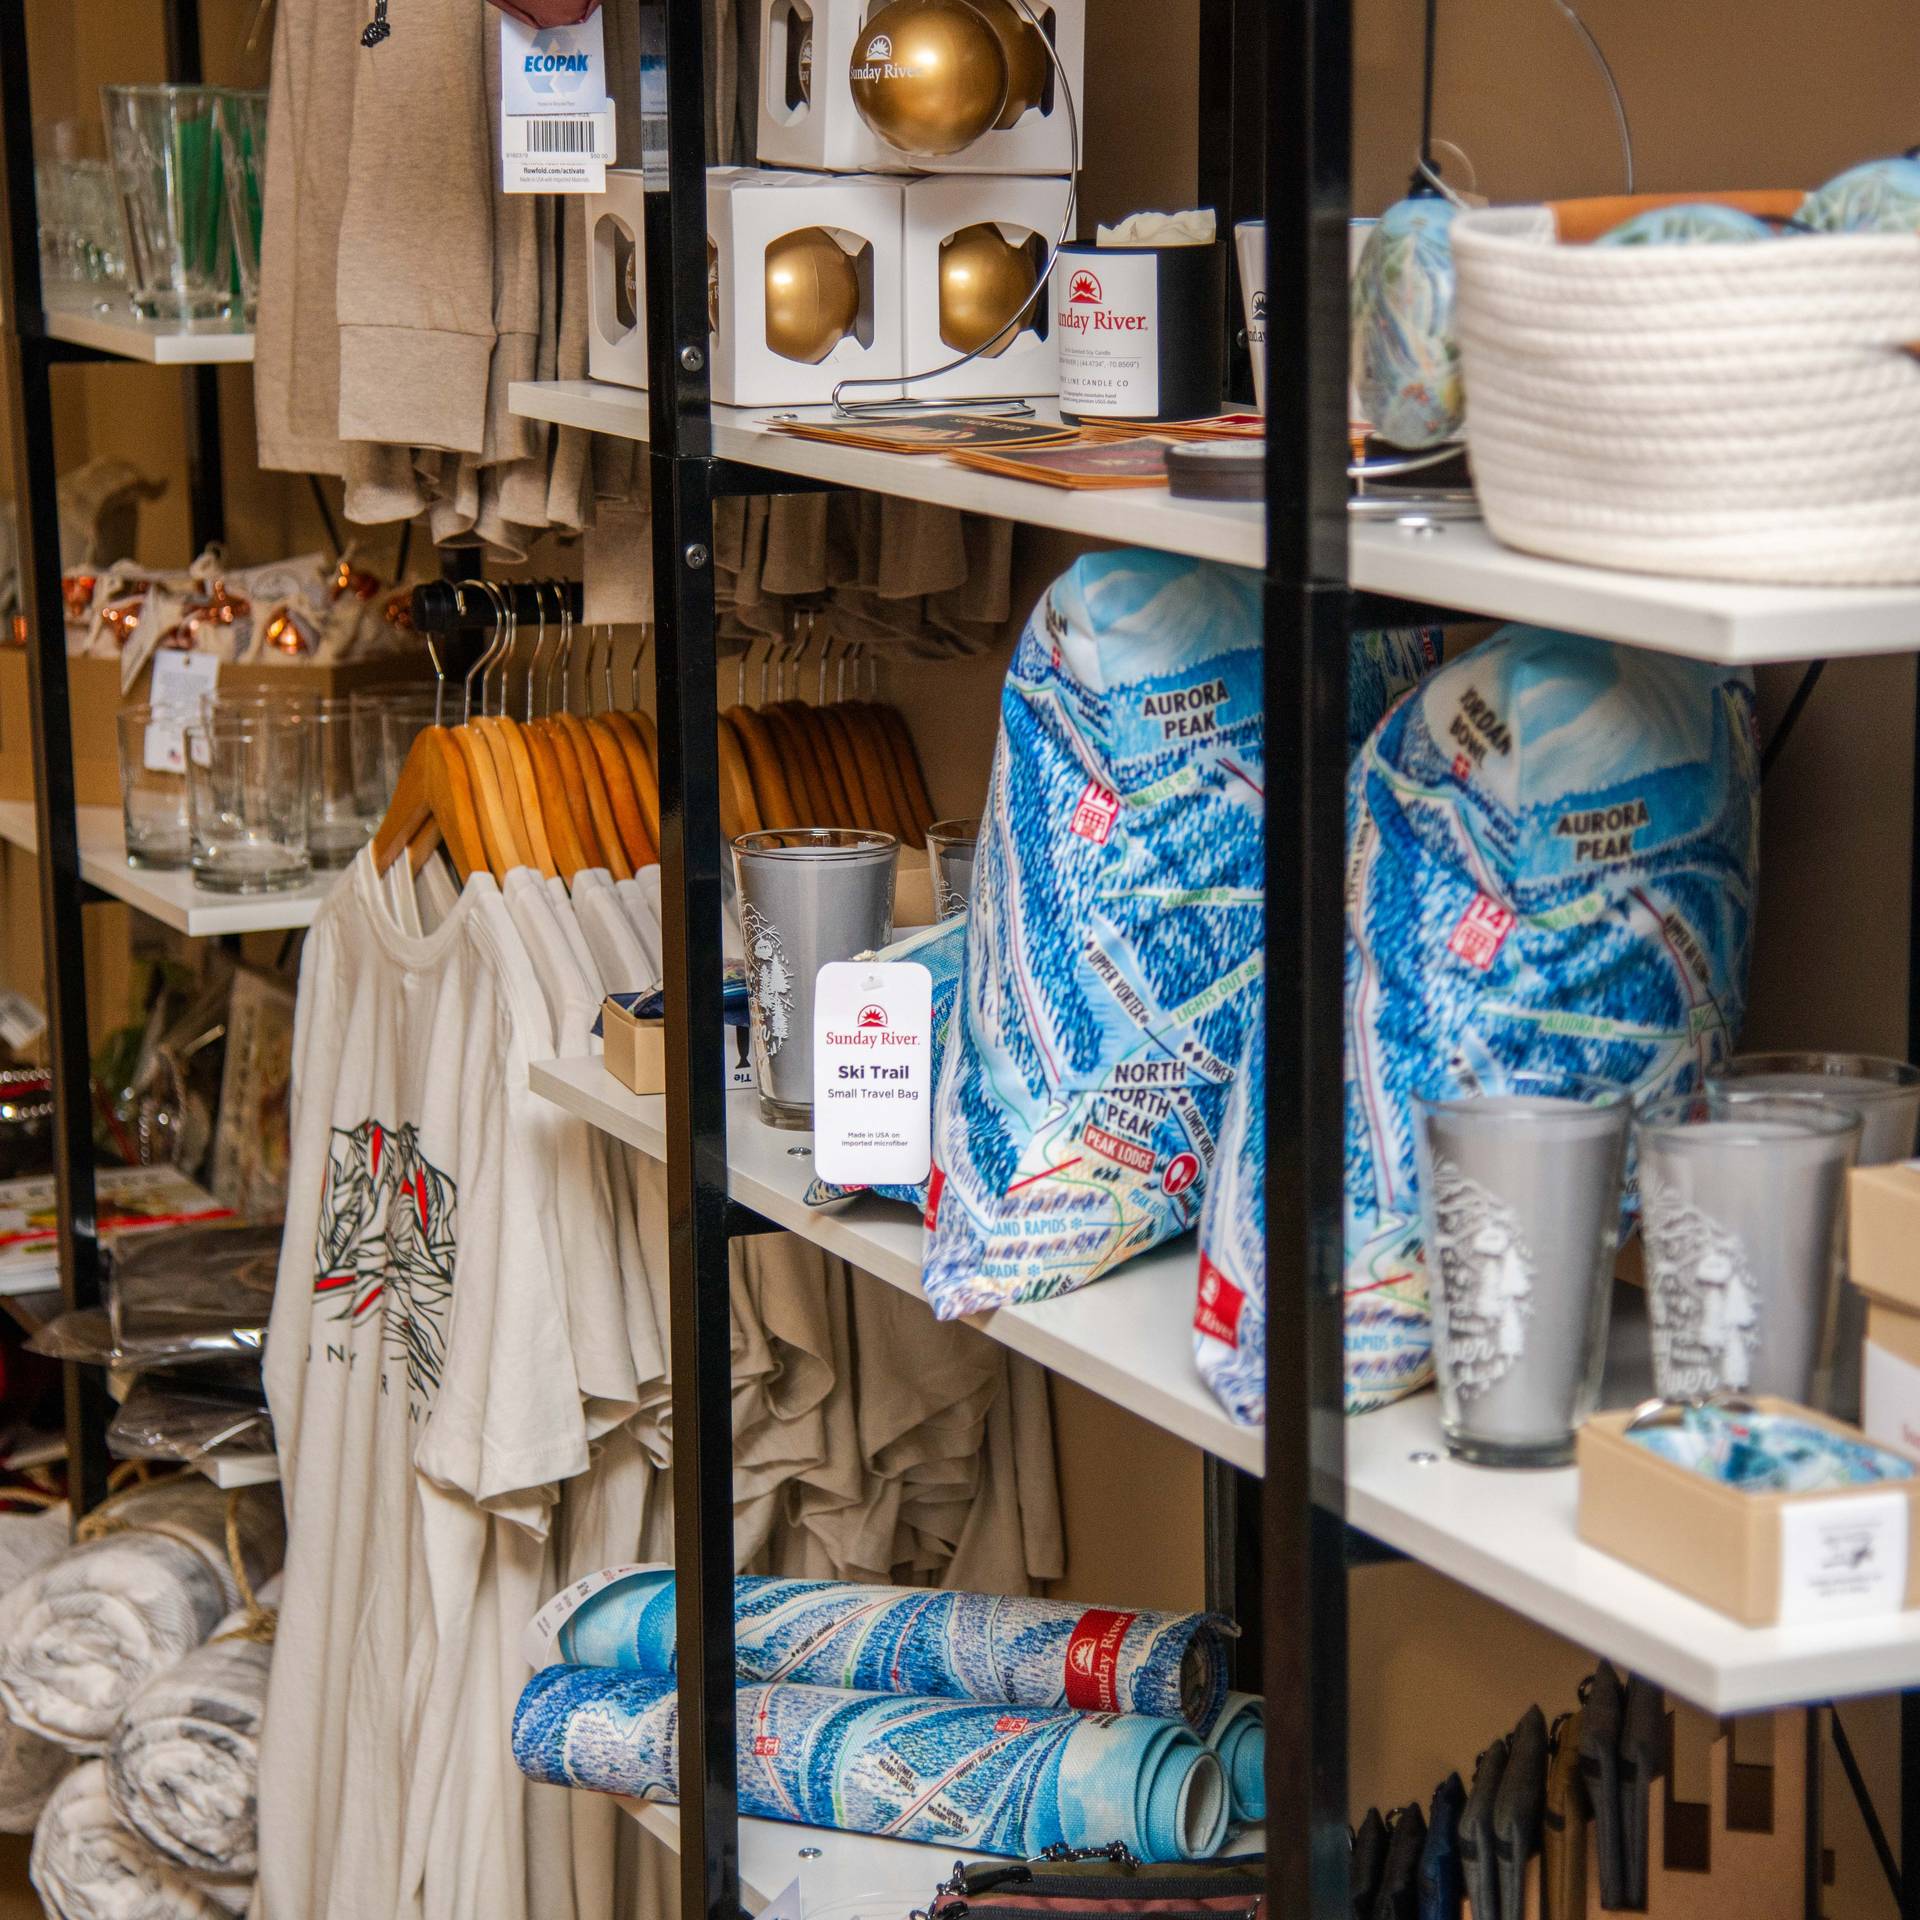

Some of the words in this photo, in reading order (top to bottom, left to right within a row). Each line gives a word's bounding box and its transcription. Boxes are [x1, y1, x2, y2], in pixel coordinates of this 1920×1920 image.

[524, 55, 589, 73] ECOPAK
[1058, 308, 1089, 335] unday
[1082, 379, 1112, 387] CANDLE
[1143, 680, 1229, 717] AURORA
[1164, 711, 1217, 740] PEAK
[1556, 801, 1649, 838] AURORA
[1575, 838, 1632, 862] PEAK
[1088, 951, 1119, 985] UPPER
[1113, 976, 1146, 1020] VORTEX
[1176, 989, 1218, 1023] LIGHTS
[1218, 972, 1243, 997] OUT
[826, 1031, 877, 1048] Sunday
[838, 1065, 864, 1079] Ski
[870, 1065, 909, 1079] Trail
[1115, 1062, 1185, 1084] NORTH
[828, 1088, 857, 1098] Small
[861, 1088, 894, 1098] Travel
[897, 1089, 919, 1100] Bag
[1107, 1104, 1154, 1138] PEAK
[874, 1139, 908, 1147] microfiber
[1086, 1130, 1116, 1157] PEAK
[1117, 1145, 1153, 1171] LODGE
[1024, 1218, 1066, 1234] RAPIDS
[1101, 1614, 1128, 1650] River
